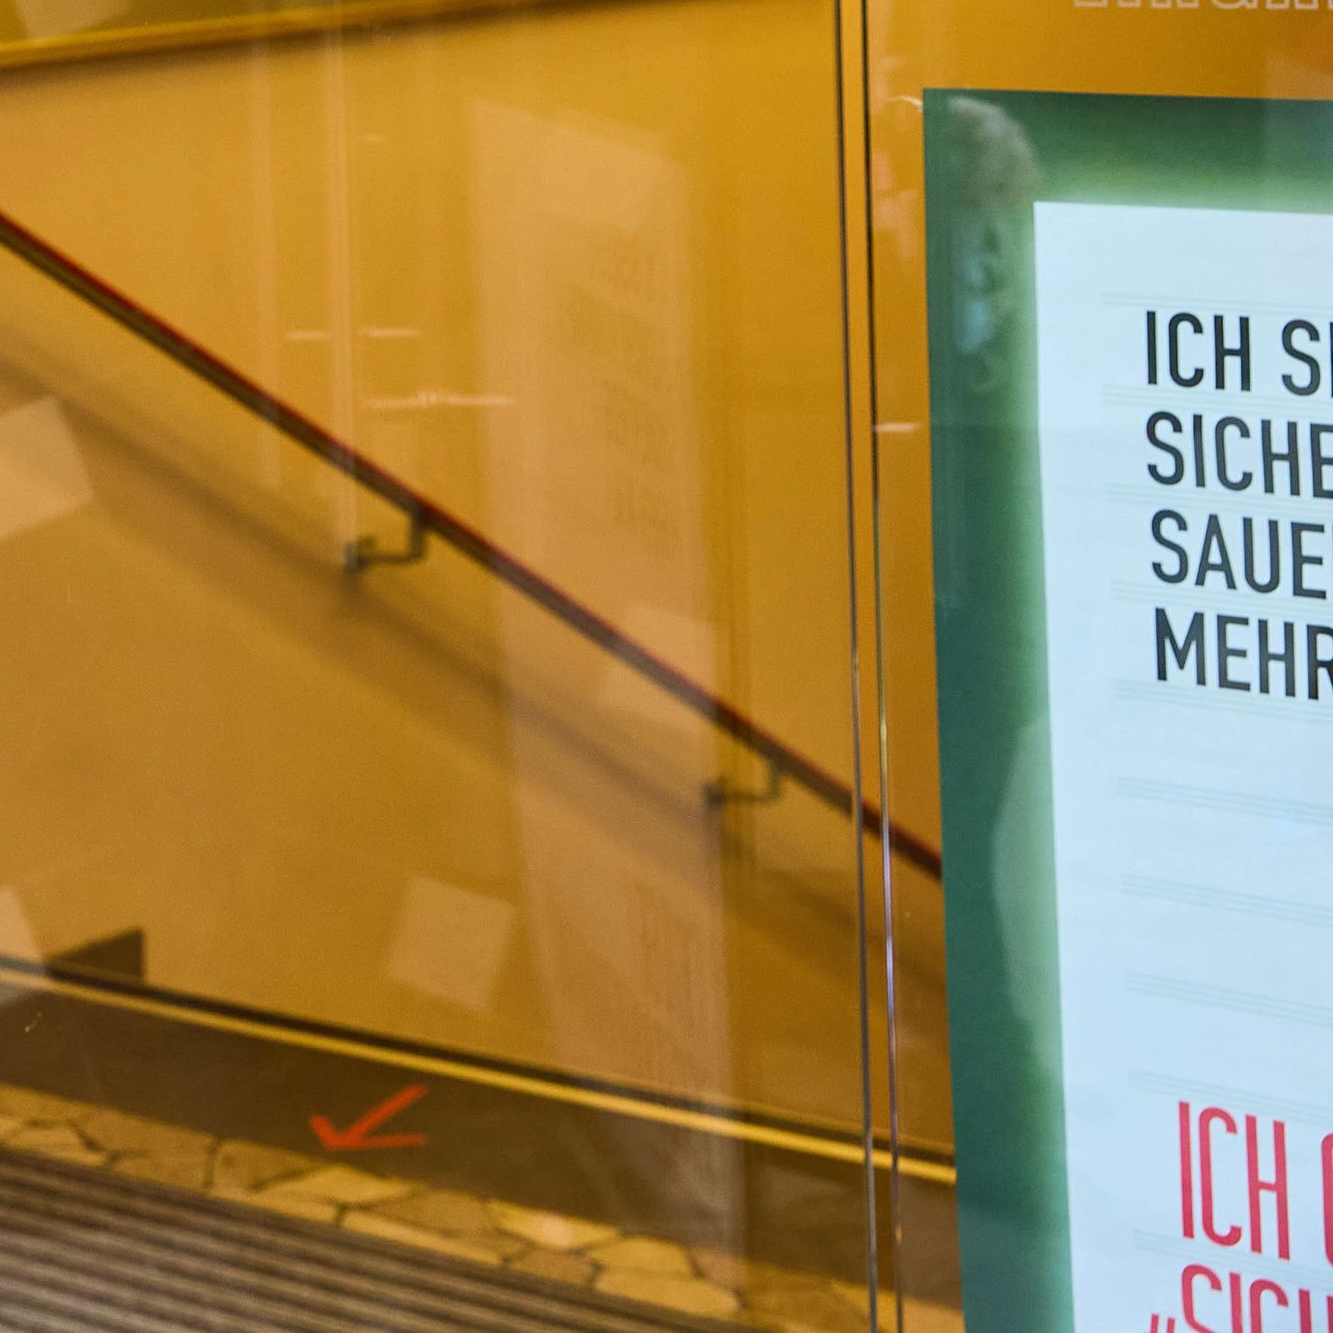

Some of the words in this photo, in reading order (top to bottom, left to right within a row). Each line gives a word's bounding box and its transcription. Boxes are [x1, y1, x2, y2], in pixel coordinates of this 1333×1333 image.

[1146, 310, 1251, 392] ICH
[1281, 319, 1333, 398] S
[1146, 411, 1333, 500] SICHE
[1151, 509, 1333, 600] SAUE
[1155, 607, 1333, 701] MEHR
[1178, 1100, 1290, 1262] ICH
